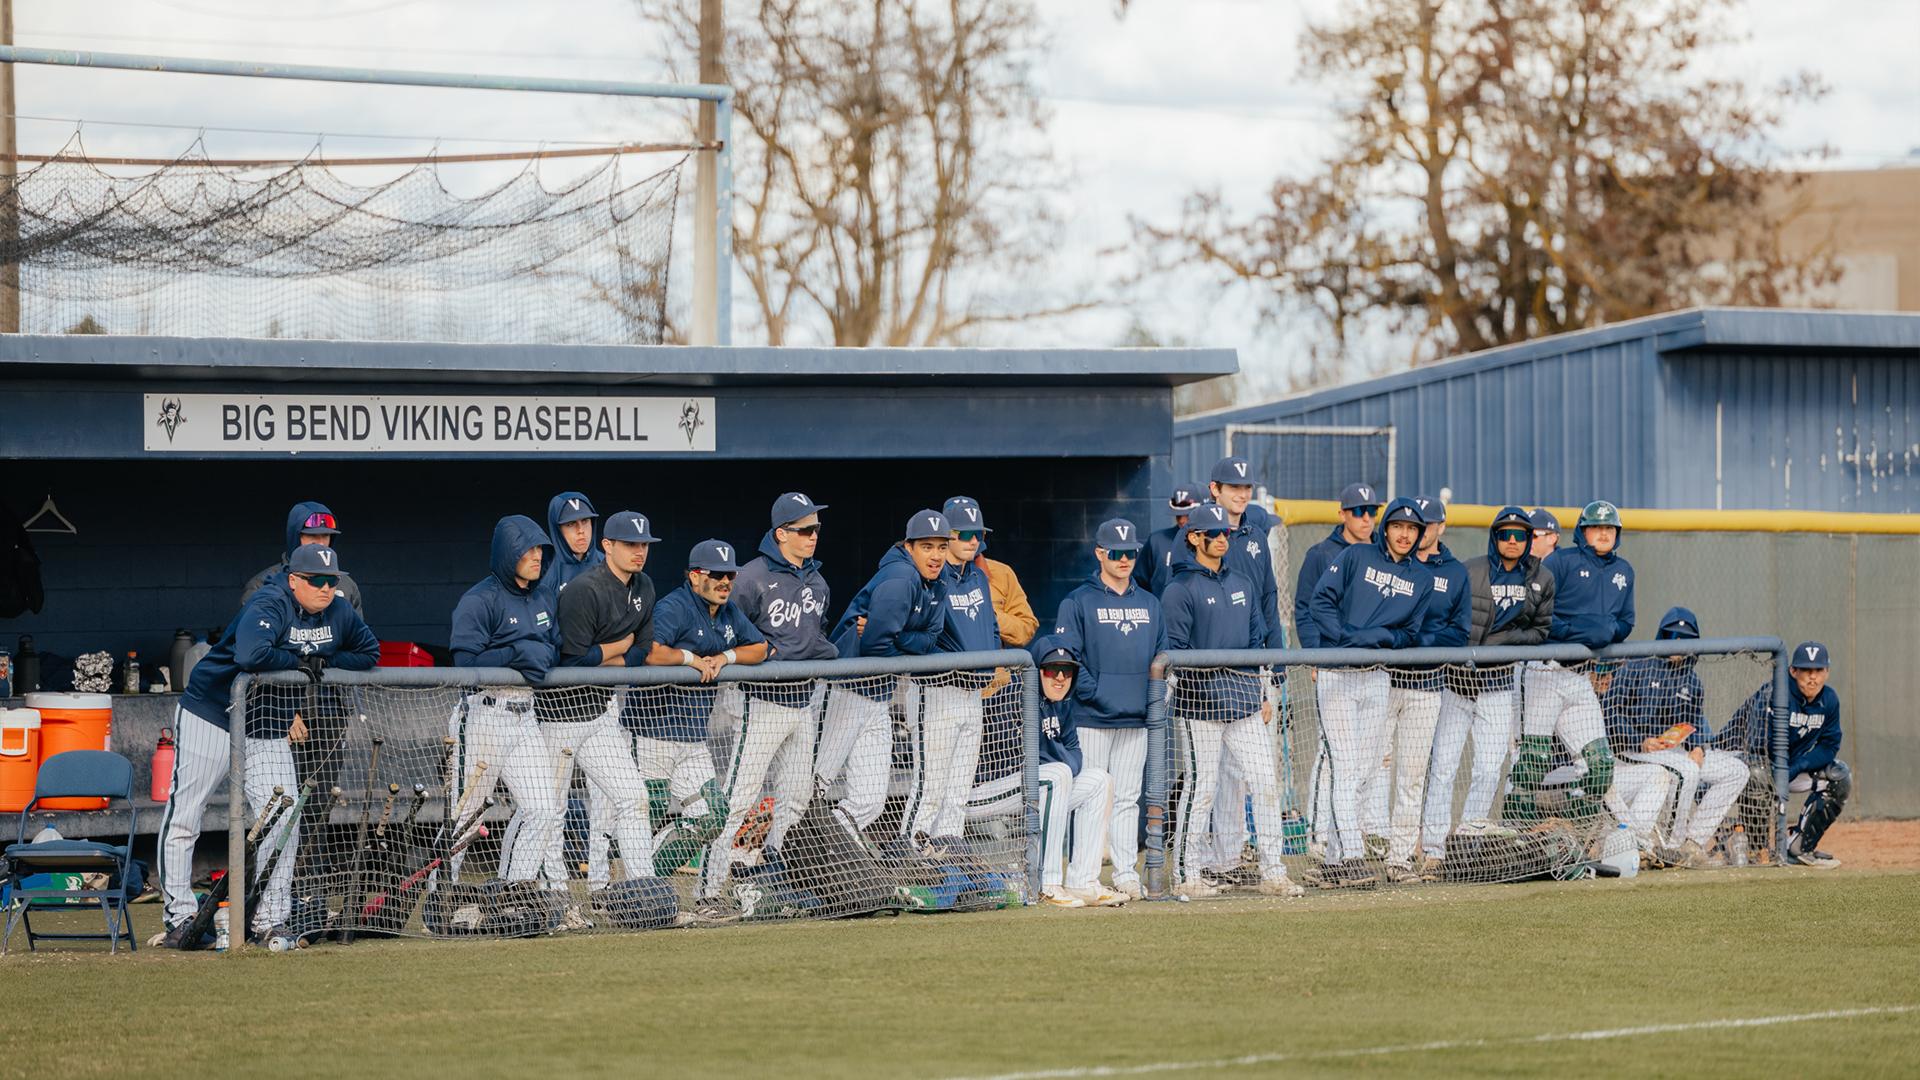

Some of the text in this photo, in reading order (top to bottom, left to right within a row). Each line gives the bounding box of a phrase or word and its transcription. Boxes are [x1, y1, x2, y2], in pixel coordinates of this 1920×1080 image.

[222, 404, 648, 442] BIG BEND VIKING BASEBALL
[1233, 462, 1248, 478] V
[792, 493, 809, 506] V
[1176, 490, 1189, 503] V
[1358, 487, 1370, 501] V
[568, 498, 581, 511] V
[964, 507, 978, 522] V
[1209, 507, 1223, 521] V
[631, 518, 645, 534] V
[927, 517, 941, 532] V
[1115, 525, 1130, 541] V
[317, 550, 332, 566] V
[715, 546, 730, 562] V
[767, 598, 802, 628] Big
[1108, 608, 1124, 620] BEND
[1124, 608, 1150, 620] BASEBALL
[1805, 646, 1820, 661] V
